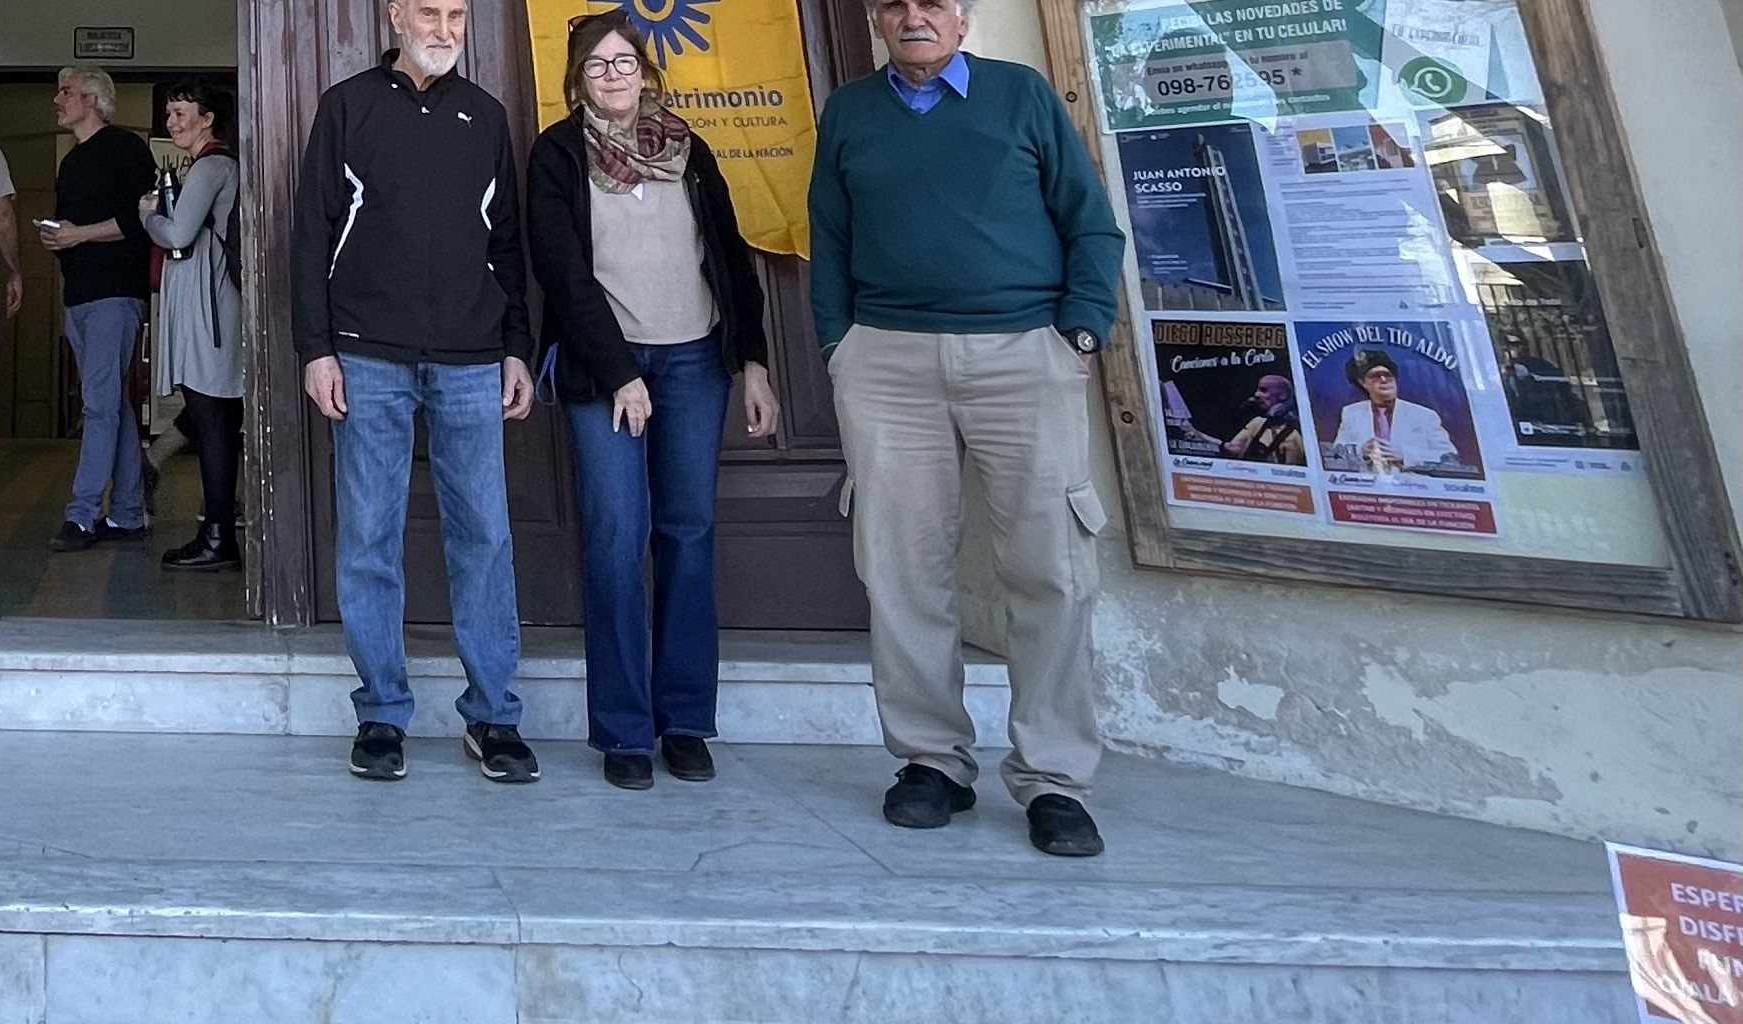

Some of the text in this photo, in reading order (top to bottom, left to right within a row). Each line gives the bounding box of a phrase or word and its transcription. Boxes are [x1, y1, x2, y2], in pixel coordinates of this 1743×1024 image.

[1208, 9, 1233, 24] LAS
[1236, 2, 1319, 22] NOVEDADES
[1235, 27, 1253, 43] EN
[1258, 25, 1277, 40] TU
[662, 85, 784, 109] atrimonio
[721, 117, 729, 126] Y
[732, 116, 787, 128] CULTURA
[729, 148, 741, 158] DE
[743, 148, 754, 158] LA
[1133, 166, 1227, 181] JUAN ANTONIO
[1134, 181, 1183, 194] SCASSO
[1154, 322, 1286, 348] DIEGO ROSSBERG
[1301, 349, 1324, 370] EL
[1316, 328, 1354, 358] SHOW
[1356, 326, 1385, 343] DEL
[1416, 337, 1459, 370] ALDO
